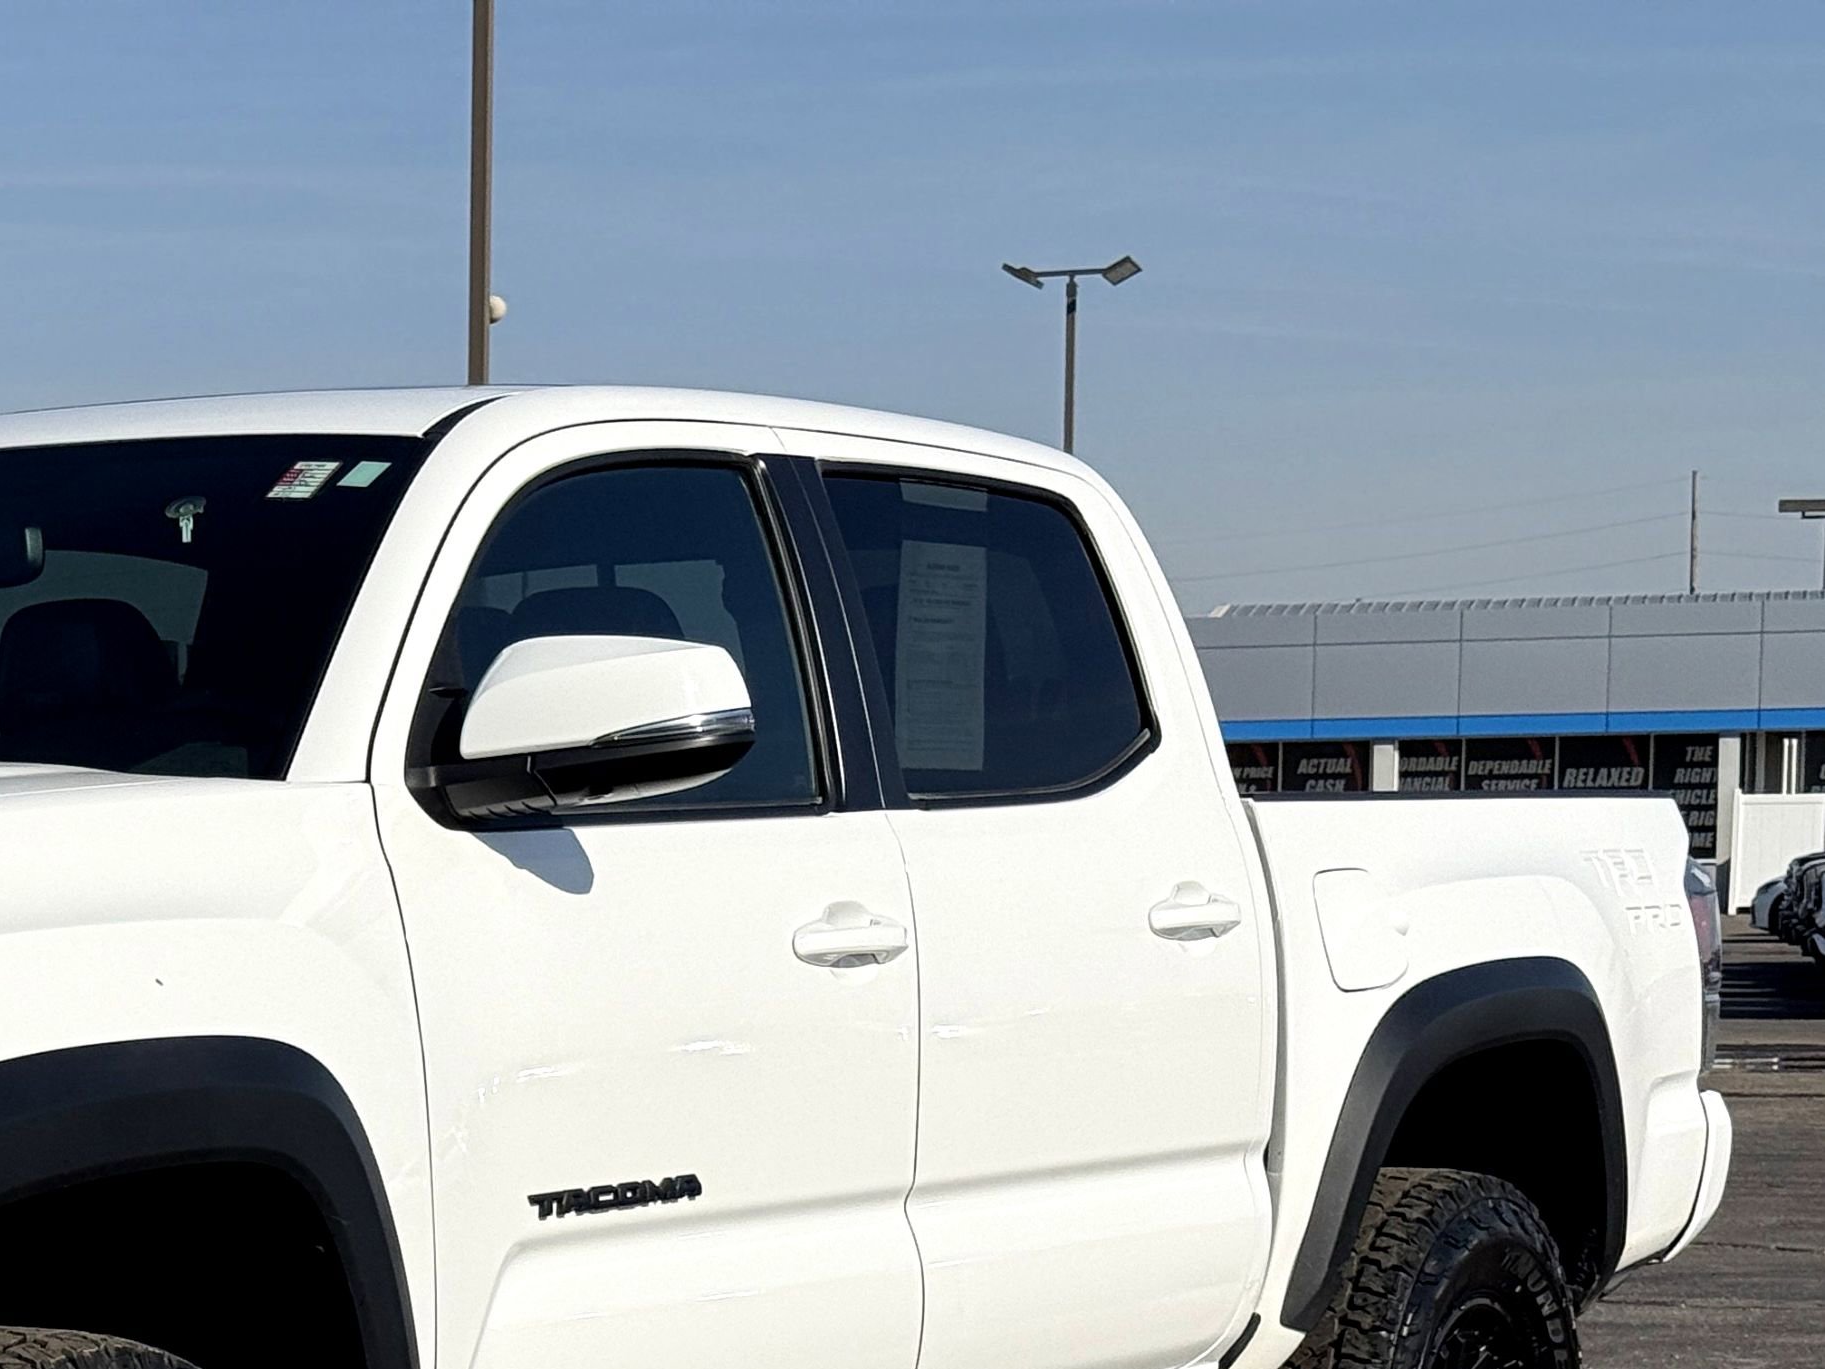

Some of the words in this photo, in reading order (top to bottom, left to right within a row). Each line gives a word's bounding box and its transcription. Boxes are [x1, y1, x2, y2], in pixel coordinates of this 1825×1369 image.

[1685, 746, 1714, 763] THE
[1296, 757, 1353, 775] ACTUAL
[1399, 756, 1459, 772] ORDABLE
[1467, 759, 1553, 776] DEPENDABLE
[1304, 778, 1348, 793] CASH
[1400, 775, 1452, 792] ANCIAL
[1562, 766, 1645, 788] RELAXED
[1674, 789, 1717, 806] HICLE
[1688, 811, 1716, 827] RIG
[527, 1173, 703, 1221] TACOMA
